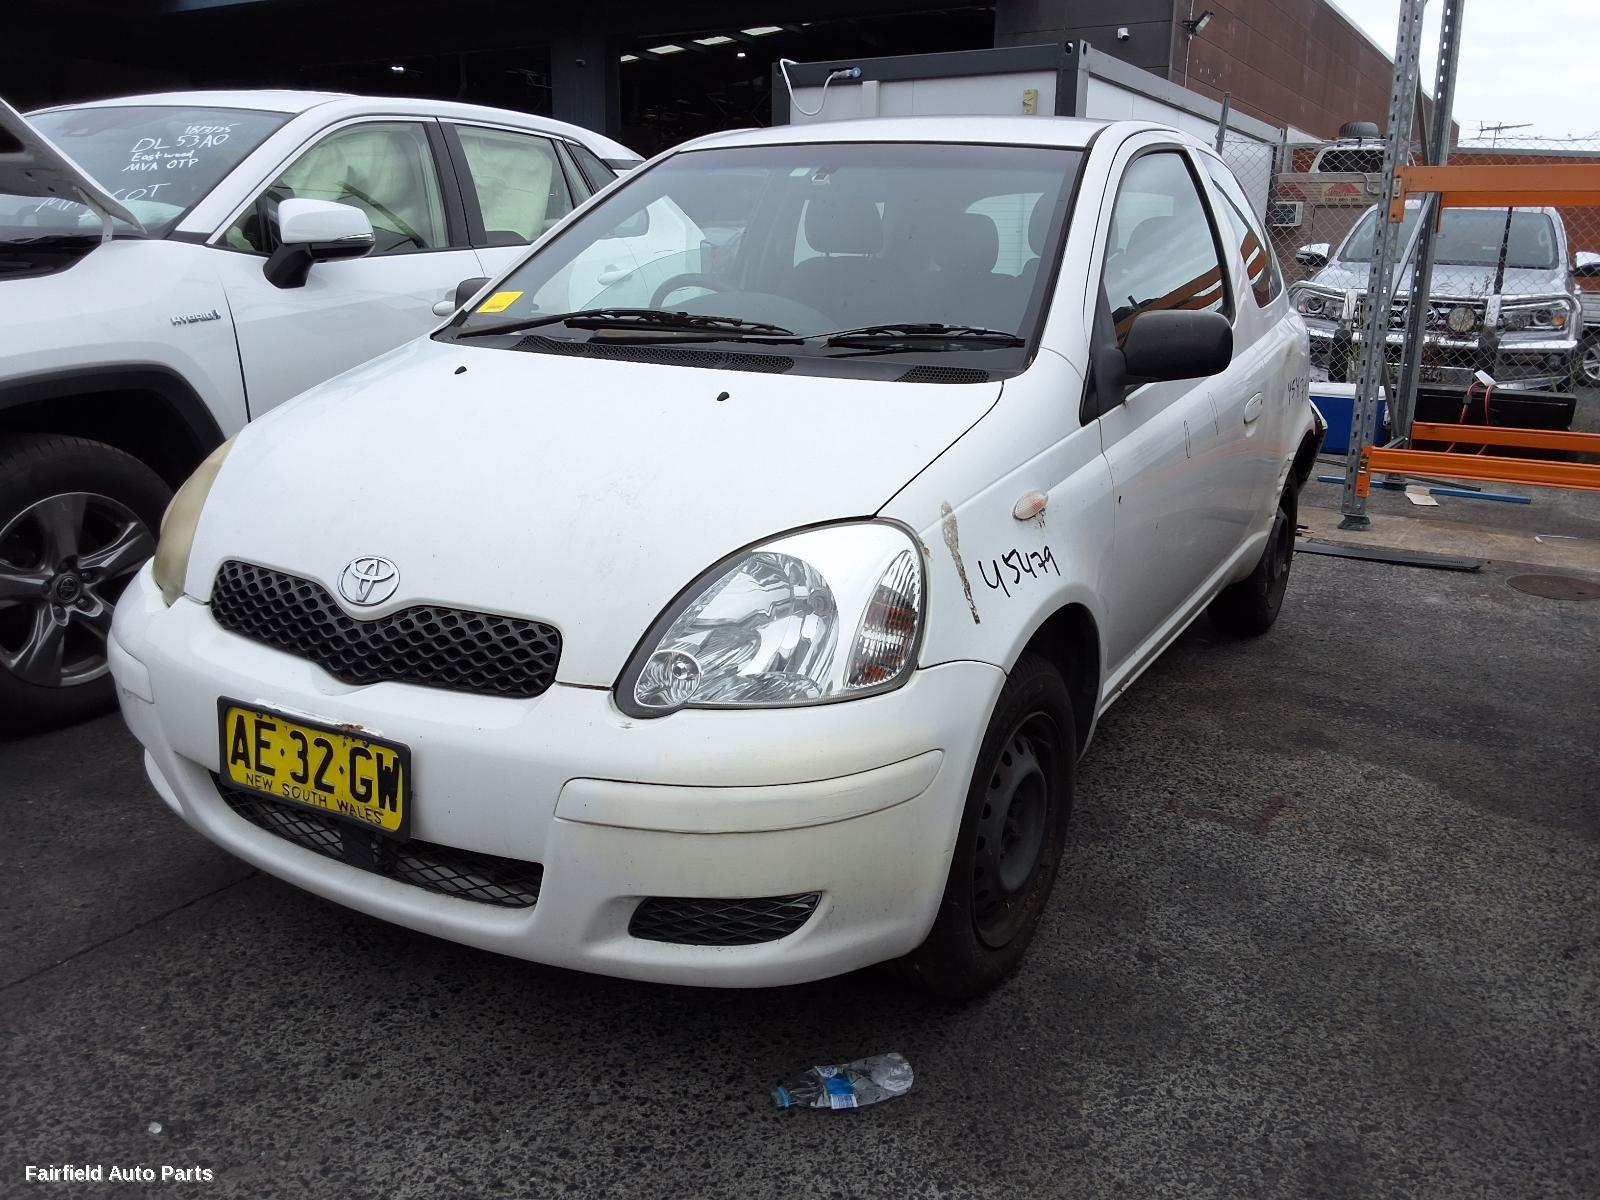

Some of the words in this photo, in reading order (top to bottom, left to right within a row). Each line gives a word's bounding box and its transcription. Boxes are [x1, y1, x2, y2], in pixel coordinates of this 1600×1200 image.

[130, 137, 171, 153] DL
[121, 162, 158, 172] MVA
[166, 158, 199, 169] OTP
[170, 312, 214, 326] HYBRID
[977, 545, 1061, 598] 45479
[246, 773, 273, 791] NEW
[282, 783, 327, 807] SOUTH
[336, 798, 384, 824] WALES
